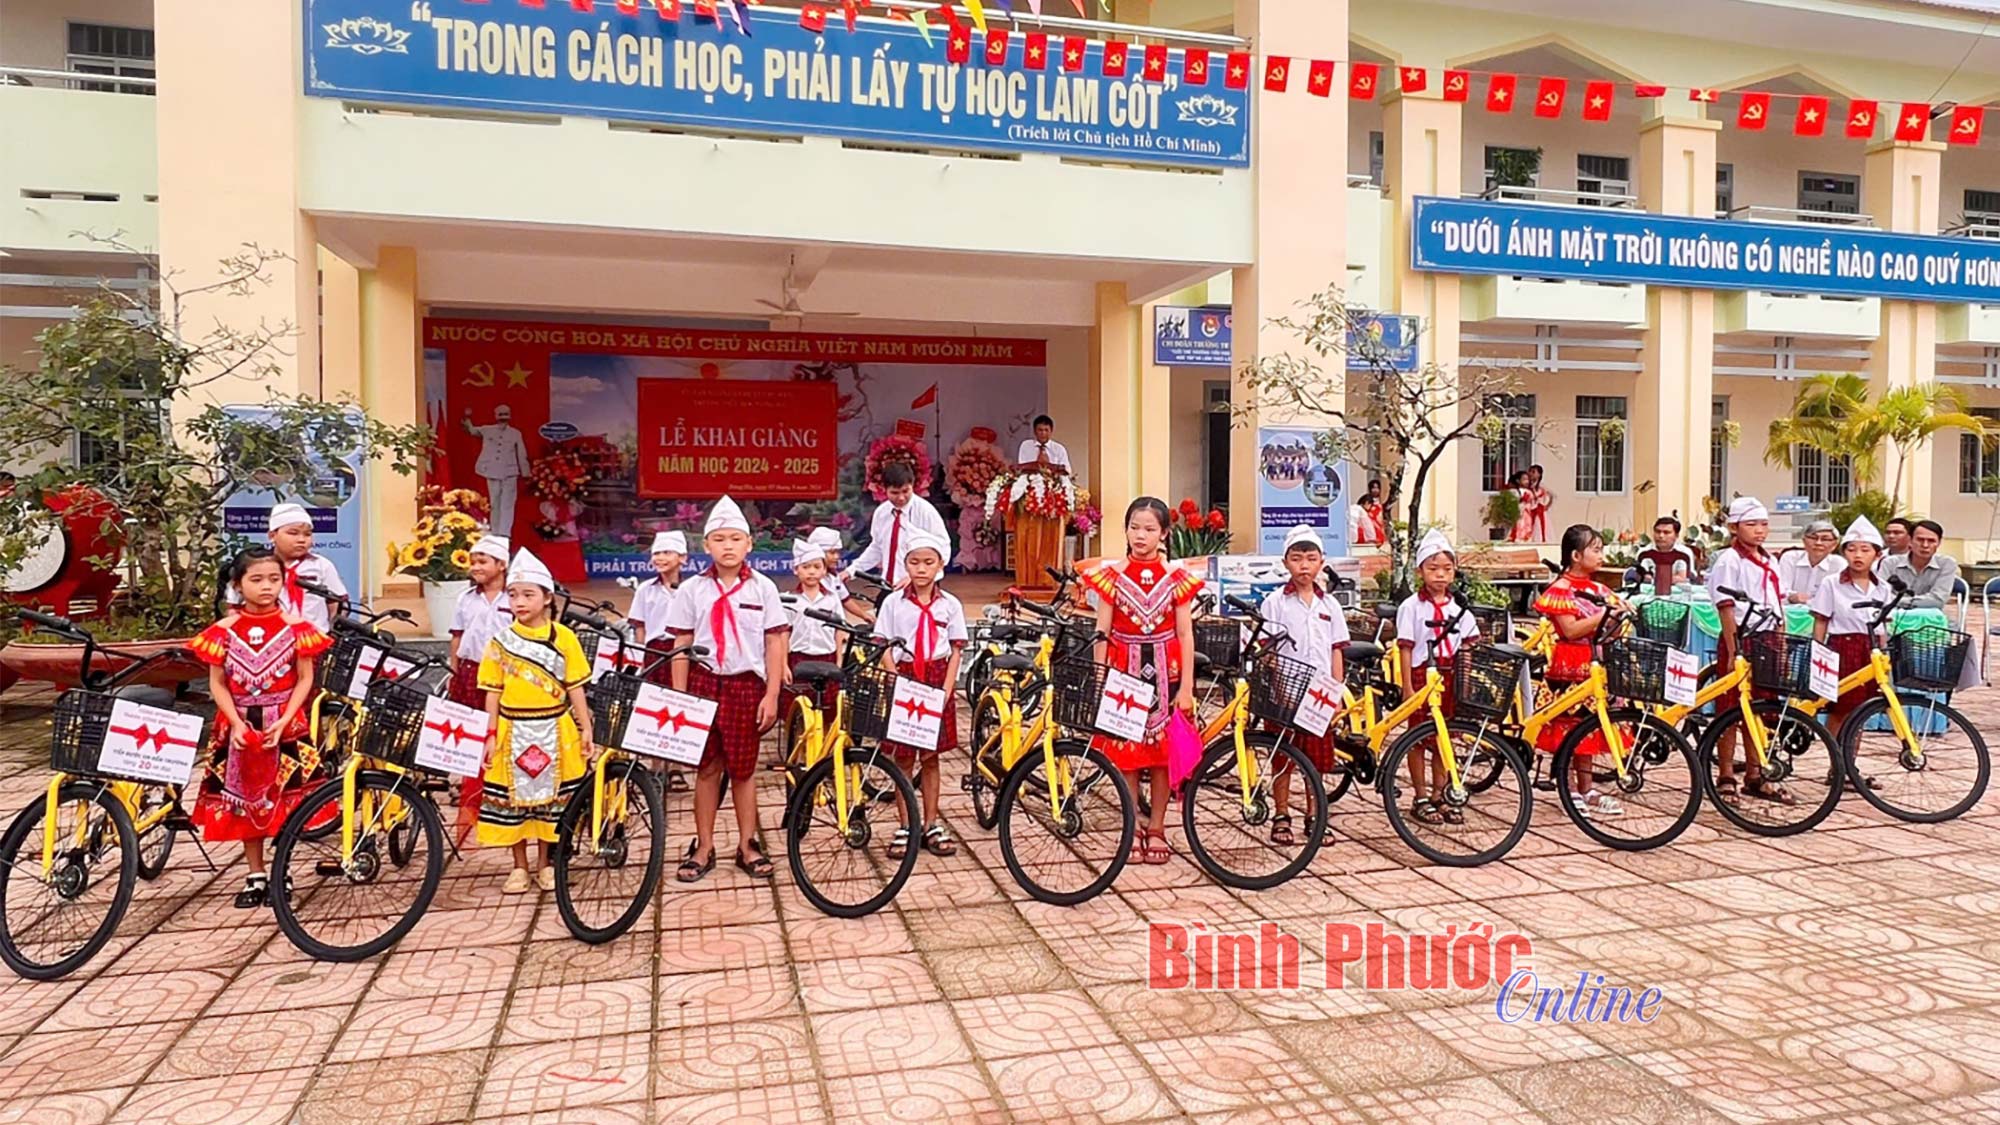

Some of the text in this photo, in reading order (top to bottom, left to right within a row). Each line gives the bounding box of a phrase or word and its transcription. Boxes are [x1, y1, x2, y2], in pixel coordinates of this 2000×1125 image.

[411, 1, 1178, 130] “TRONG CÁCH HỌC, PHẢI LẤY TỰ HỌC LÀM CỐT”
[1008, 124, 1221, 155] (Trích lời Chủ tịch Hồ Chí Minh)
[1431, 216, 2000, 287] “DƯỚI ÁNH MẶT TRỜI KHÔNG CÓ NGHỀ NÀO CAO QUÝ HƠN
[432, 323, 497, 342] NƯỚC
[502, 326, 566, 346] CỘNG
[656, 333, 693, 351] HỘI
[699, 334, 742, 351] CHỦ
[816, 337, 859, 354] VIỆT
[864, 341, 908, 356] NAM
[659, 417, 818, 448] LỄ KHAI GIẢNG
[658, 454, 694, 474] NĂM
[698, 456, 729, 478] HỌC
[733, 457, 769, 474] 2024
[783, 457, 819, 475] 2025
[592, 558, 625, 573] PHẢI
[755, 556, 777, 571] ÍCH
[658, 740, 670, 749] 20
[138, 760, 152, 769] 20
